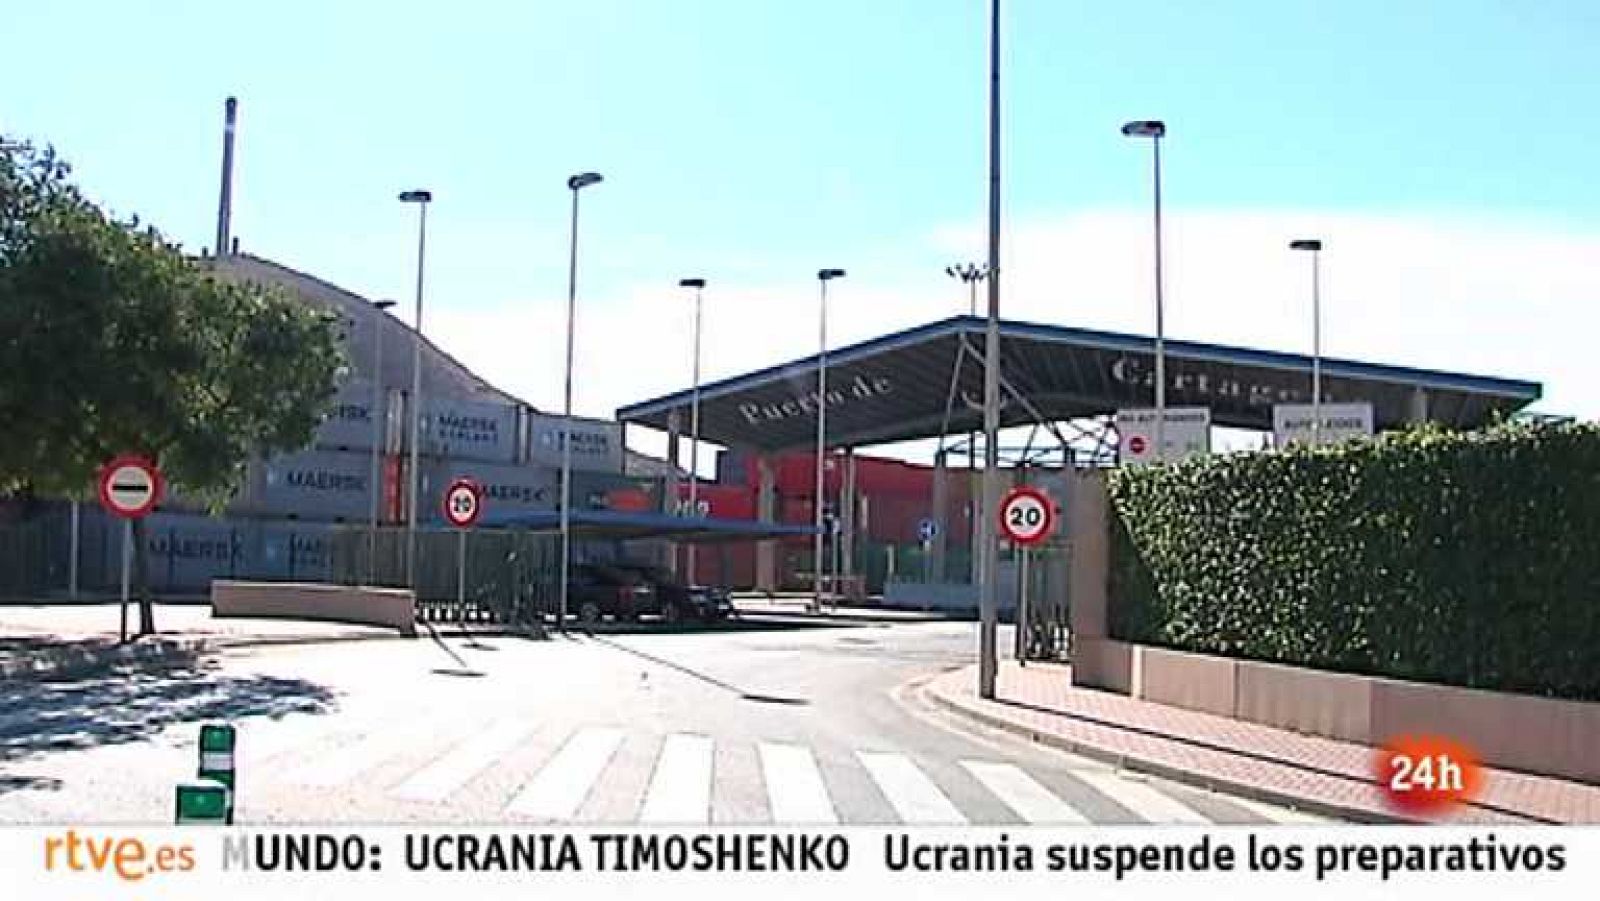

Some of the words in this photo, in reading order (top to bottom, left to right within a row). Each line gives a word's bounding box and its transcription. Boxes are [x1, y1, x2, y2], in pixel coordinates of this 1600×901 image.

[850, 373, 892, 399] de
[286, 469, 367, 490] MAERSK
[1009, 506, 1041, 527] 20
